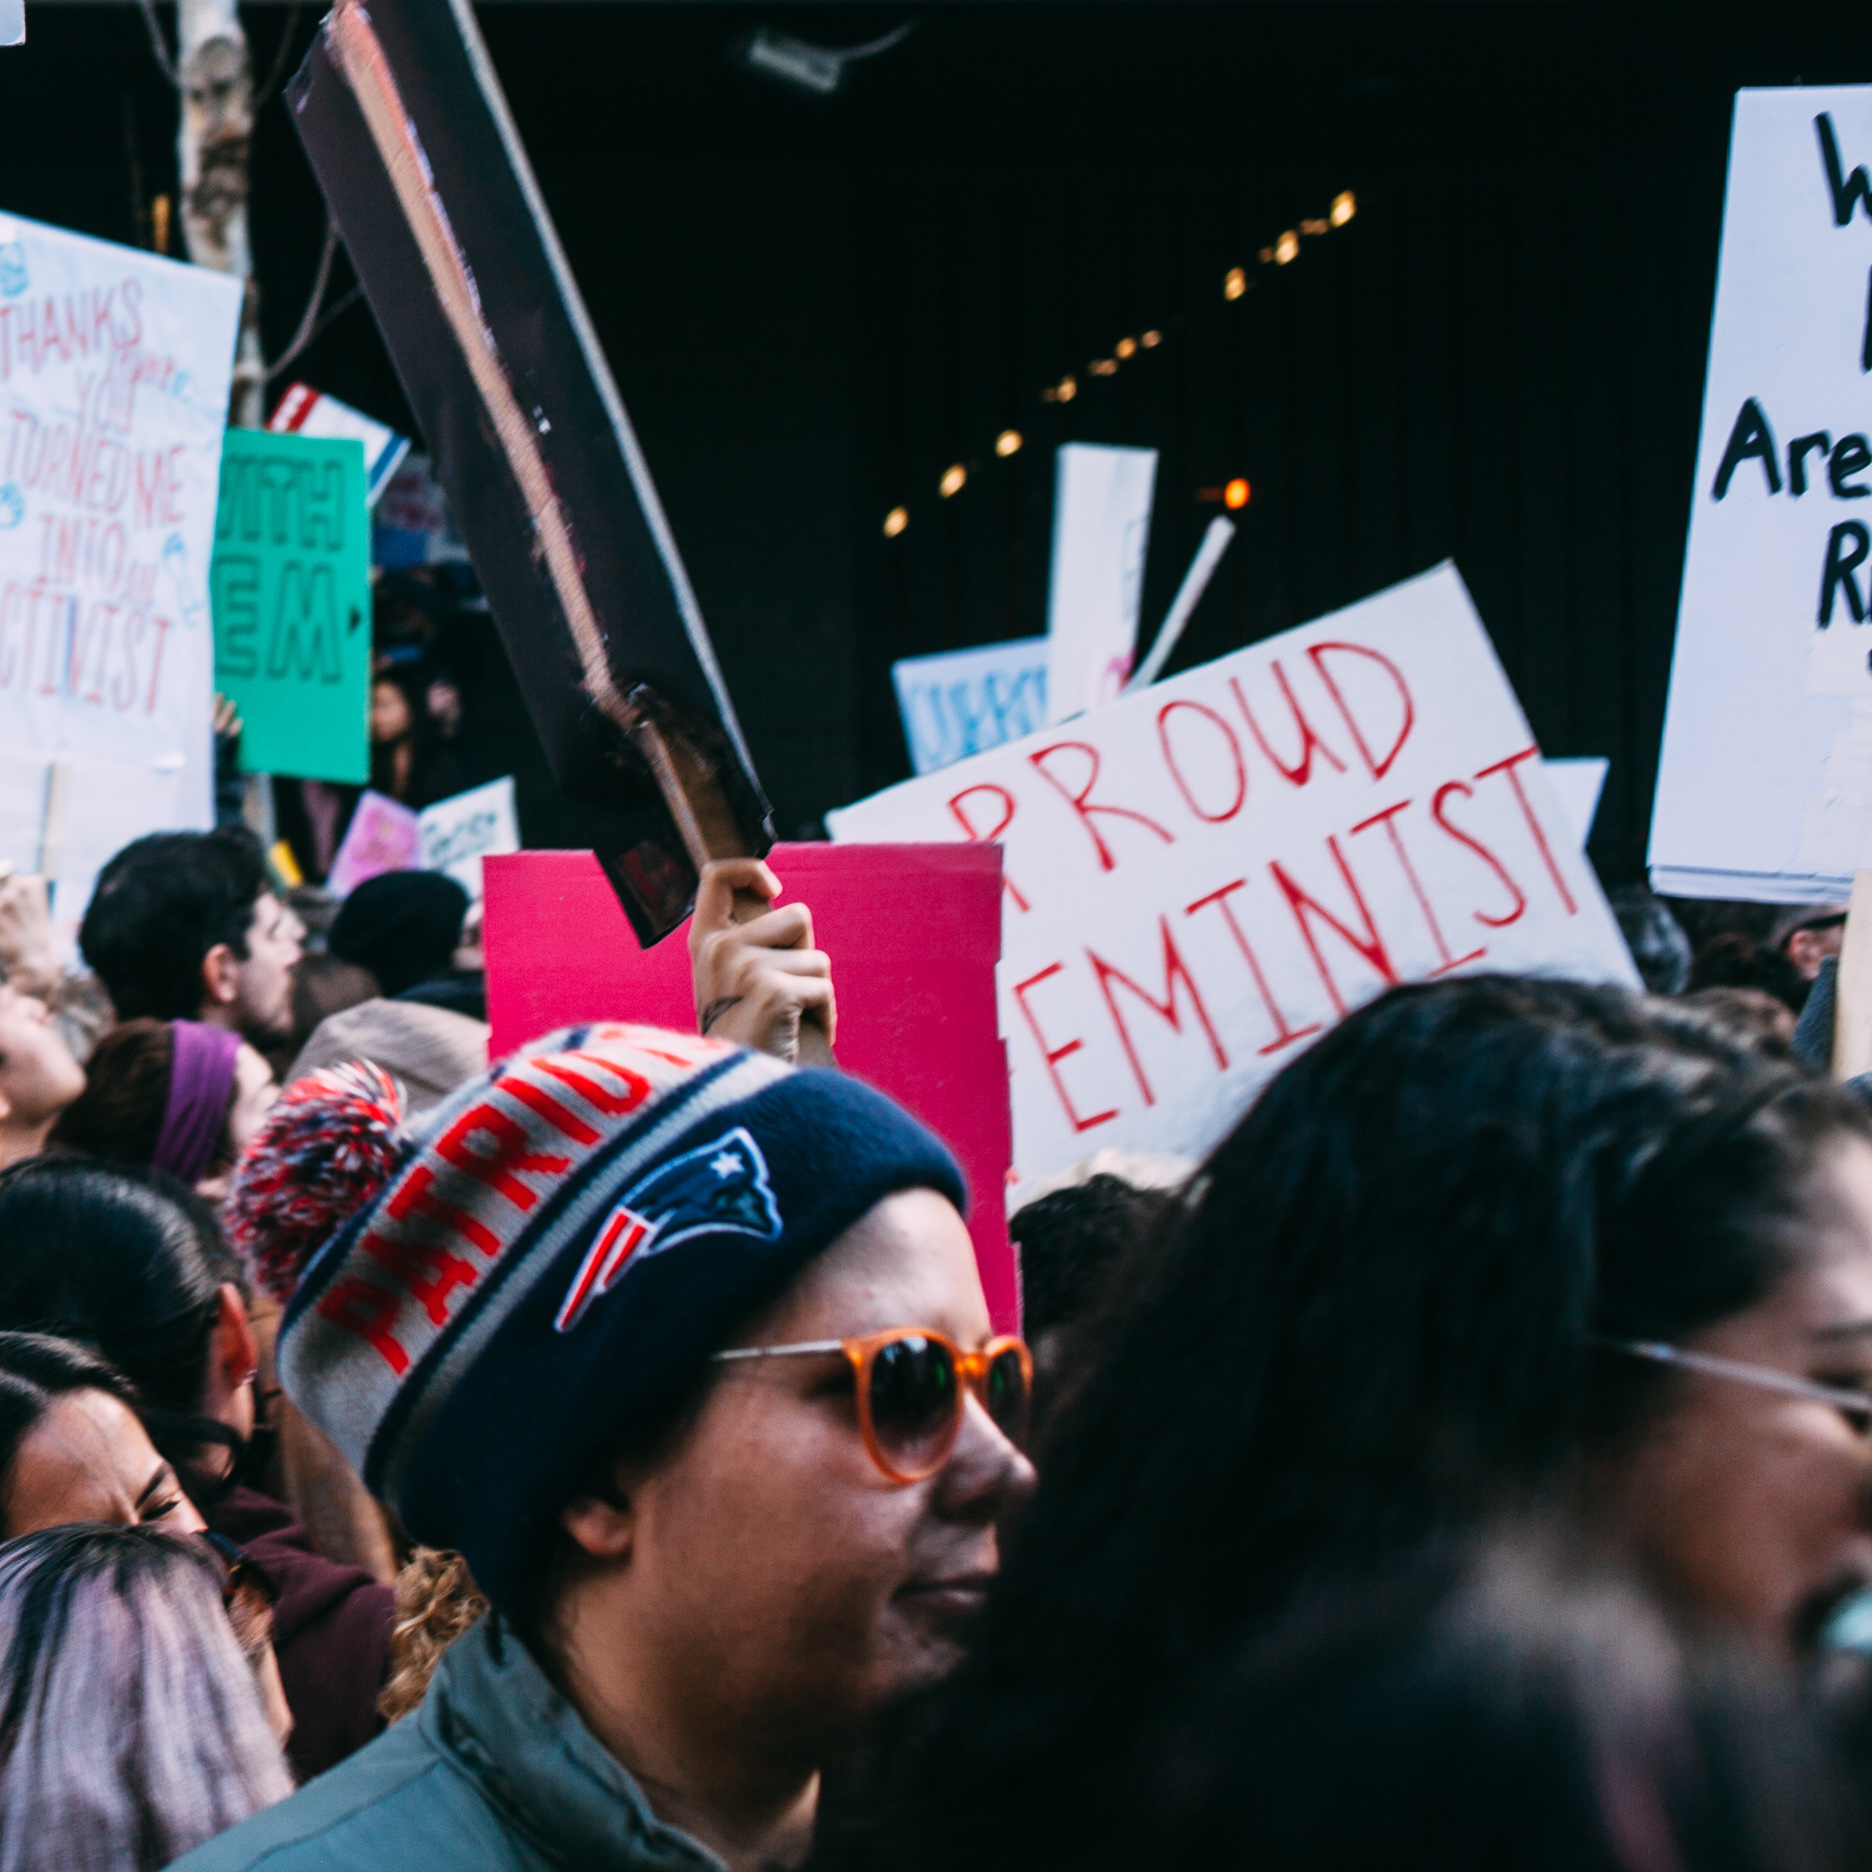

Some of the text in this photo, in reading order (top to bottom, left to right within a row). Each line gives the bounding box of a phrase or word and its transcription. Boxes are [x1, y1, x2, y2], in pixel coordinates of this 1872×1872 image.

[5, 408, 184, 530] TURNED ME
[1710, 394, 1872, 504] Are
[36, 512, 126, 591] INTO
[1816, 518, 1872, 632] R
[946, 640, 1416, 912] PROUD
[1008, 743, 1580, 1136] EMINIST
[317, 1020, 728, 1378] PATRIO
